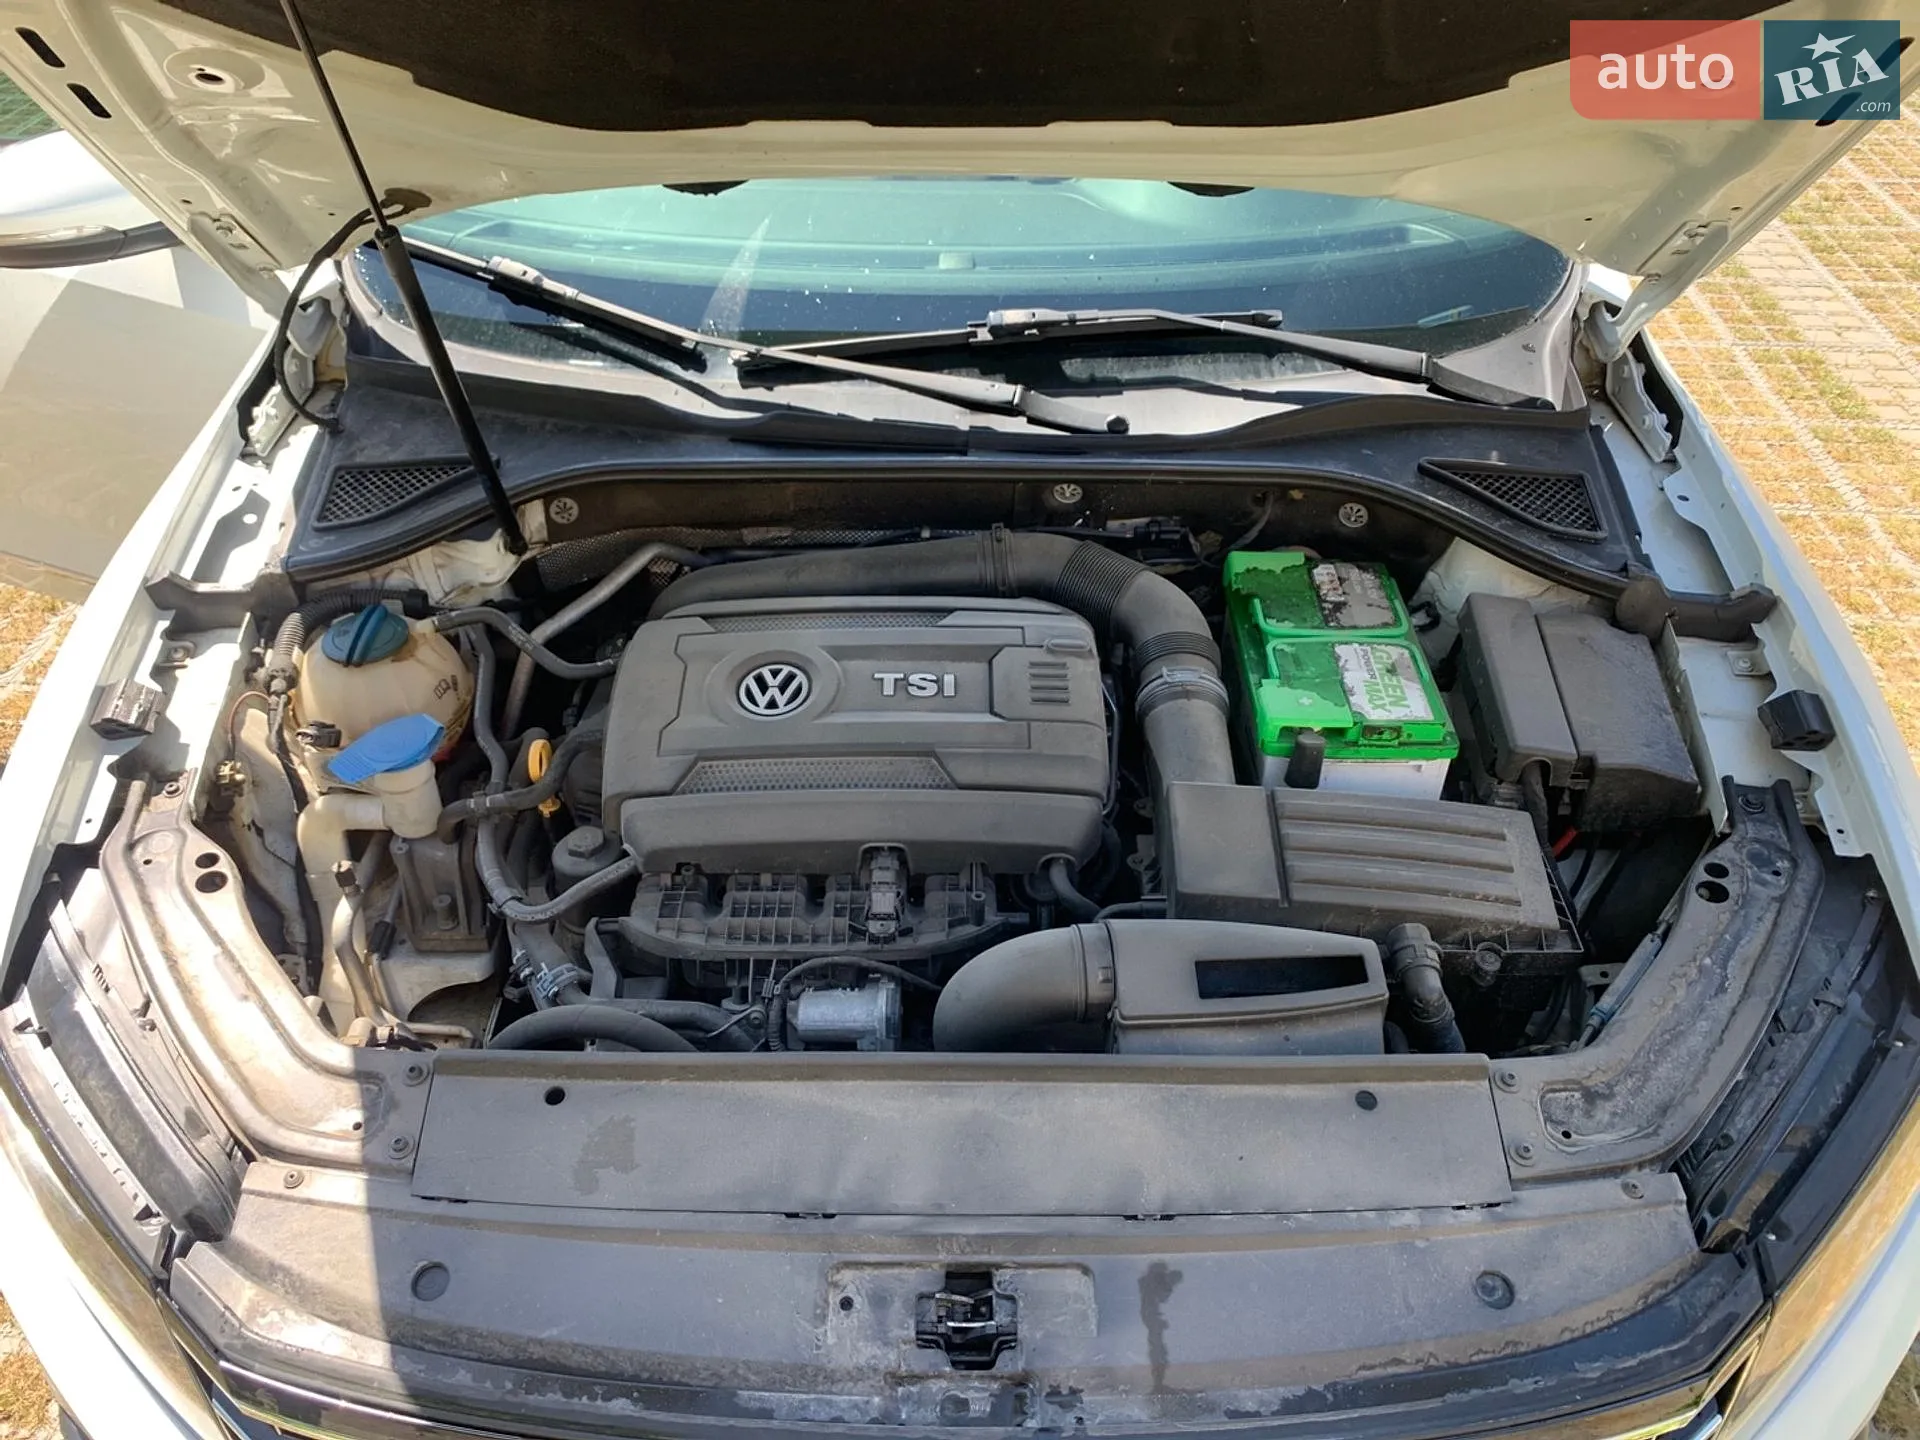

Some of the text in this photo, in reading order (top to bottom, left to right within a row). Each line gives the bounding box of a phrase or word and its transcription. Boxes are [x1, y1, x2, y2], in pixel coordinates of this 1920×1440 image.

[873, 672, 956, 698] TSI
[1360, 647, 1392, 712] POWER MAX
